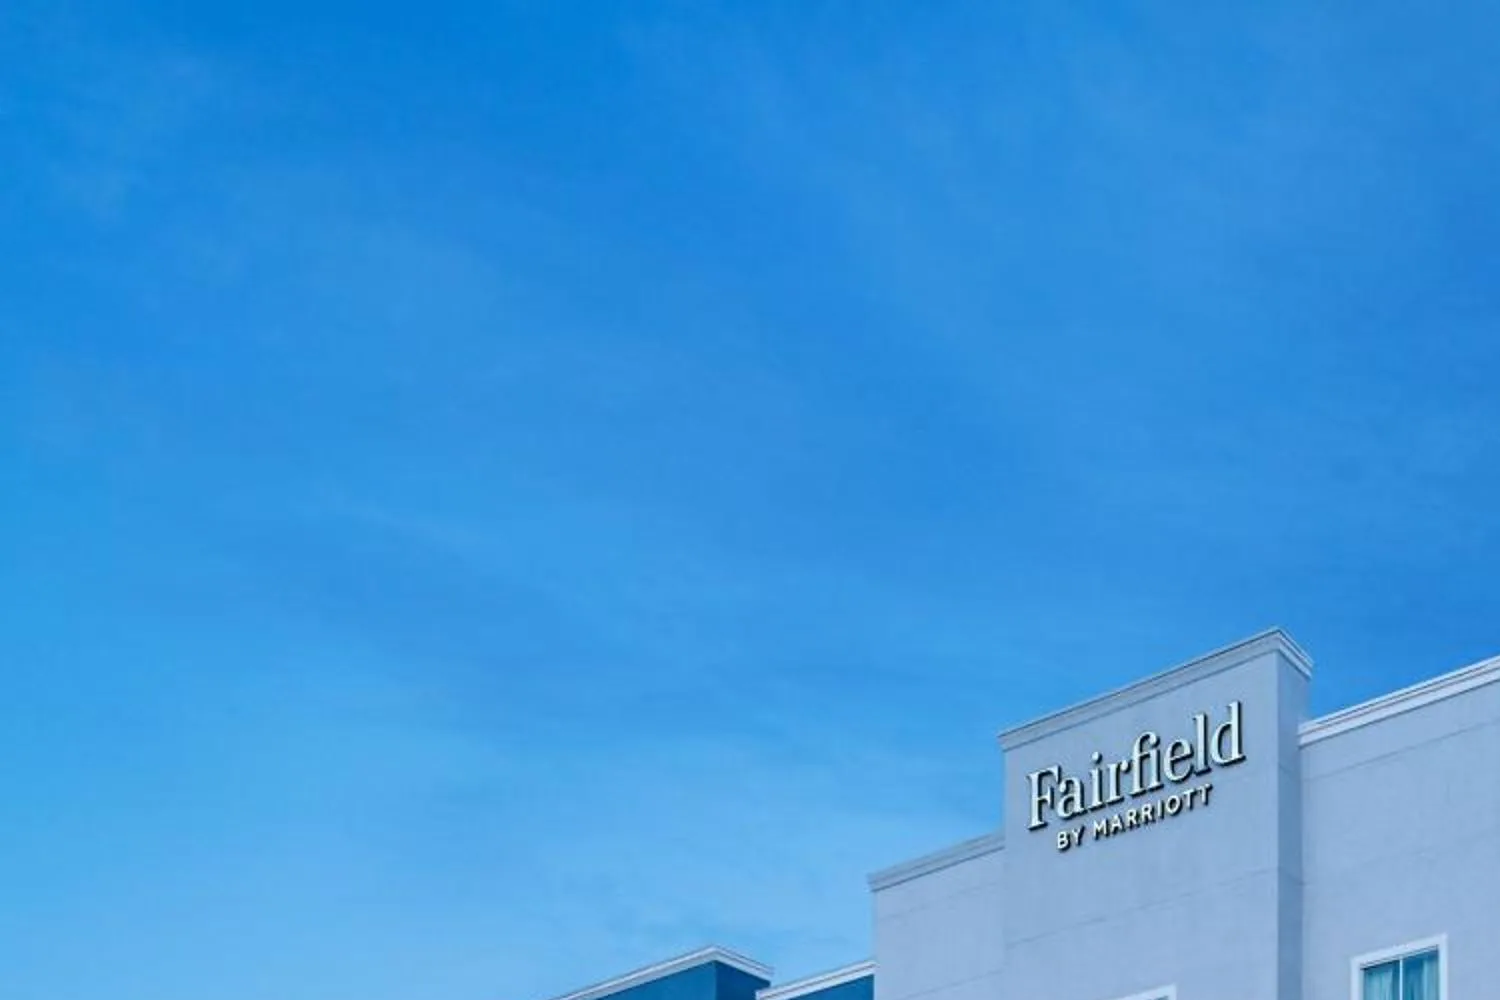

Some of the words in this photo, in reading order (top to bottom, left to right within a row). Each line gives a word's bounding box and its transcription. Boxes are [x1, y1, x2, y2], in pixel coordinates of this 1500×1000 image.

[1027, 700, 1246, 831] Fairfield
[1056, 826, 1085, 852] BY
[1093, 783, 1213, 840] MARRIOTT
